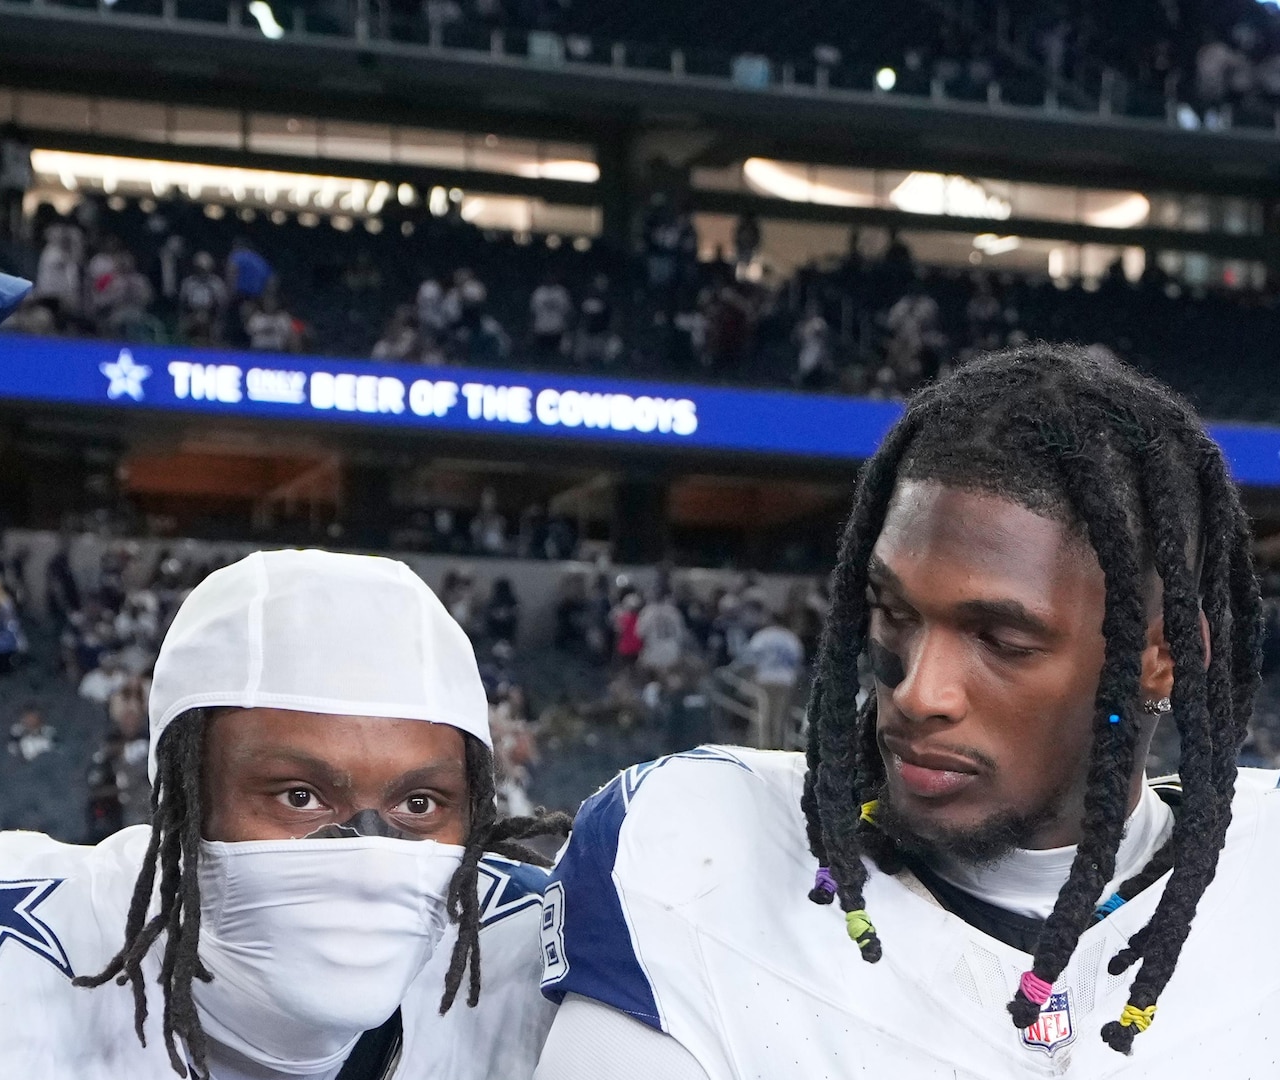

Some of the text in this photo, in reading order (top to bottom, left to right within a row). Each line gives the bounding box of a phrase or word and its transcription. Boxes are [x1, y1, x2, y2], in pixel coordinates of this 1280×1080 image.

[168, 361, 242, 403] THE
[311, 371, 405, 414] BEER
[409, 379, 458, 416] OF
[462, 382, 532, 424] THE
[536, 388, 698, 435] COWBOYS
[1027, 1012, 1068, 1043] NFL
